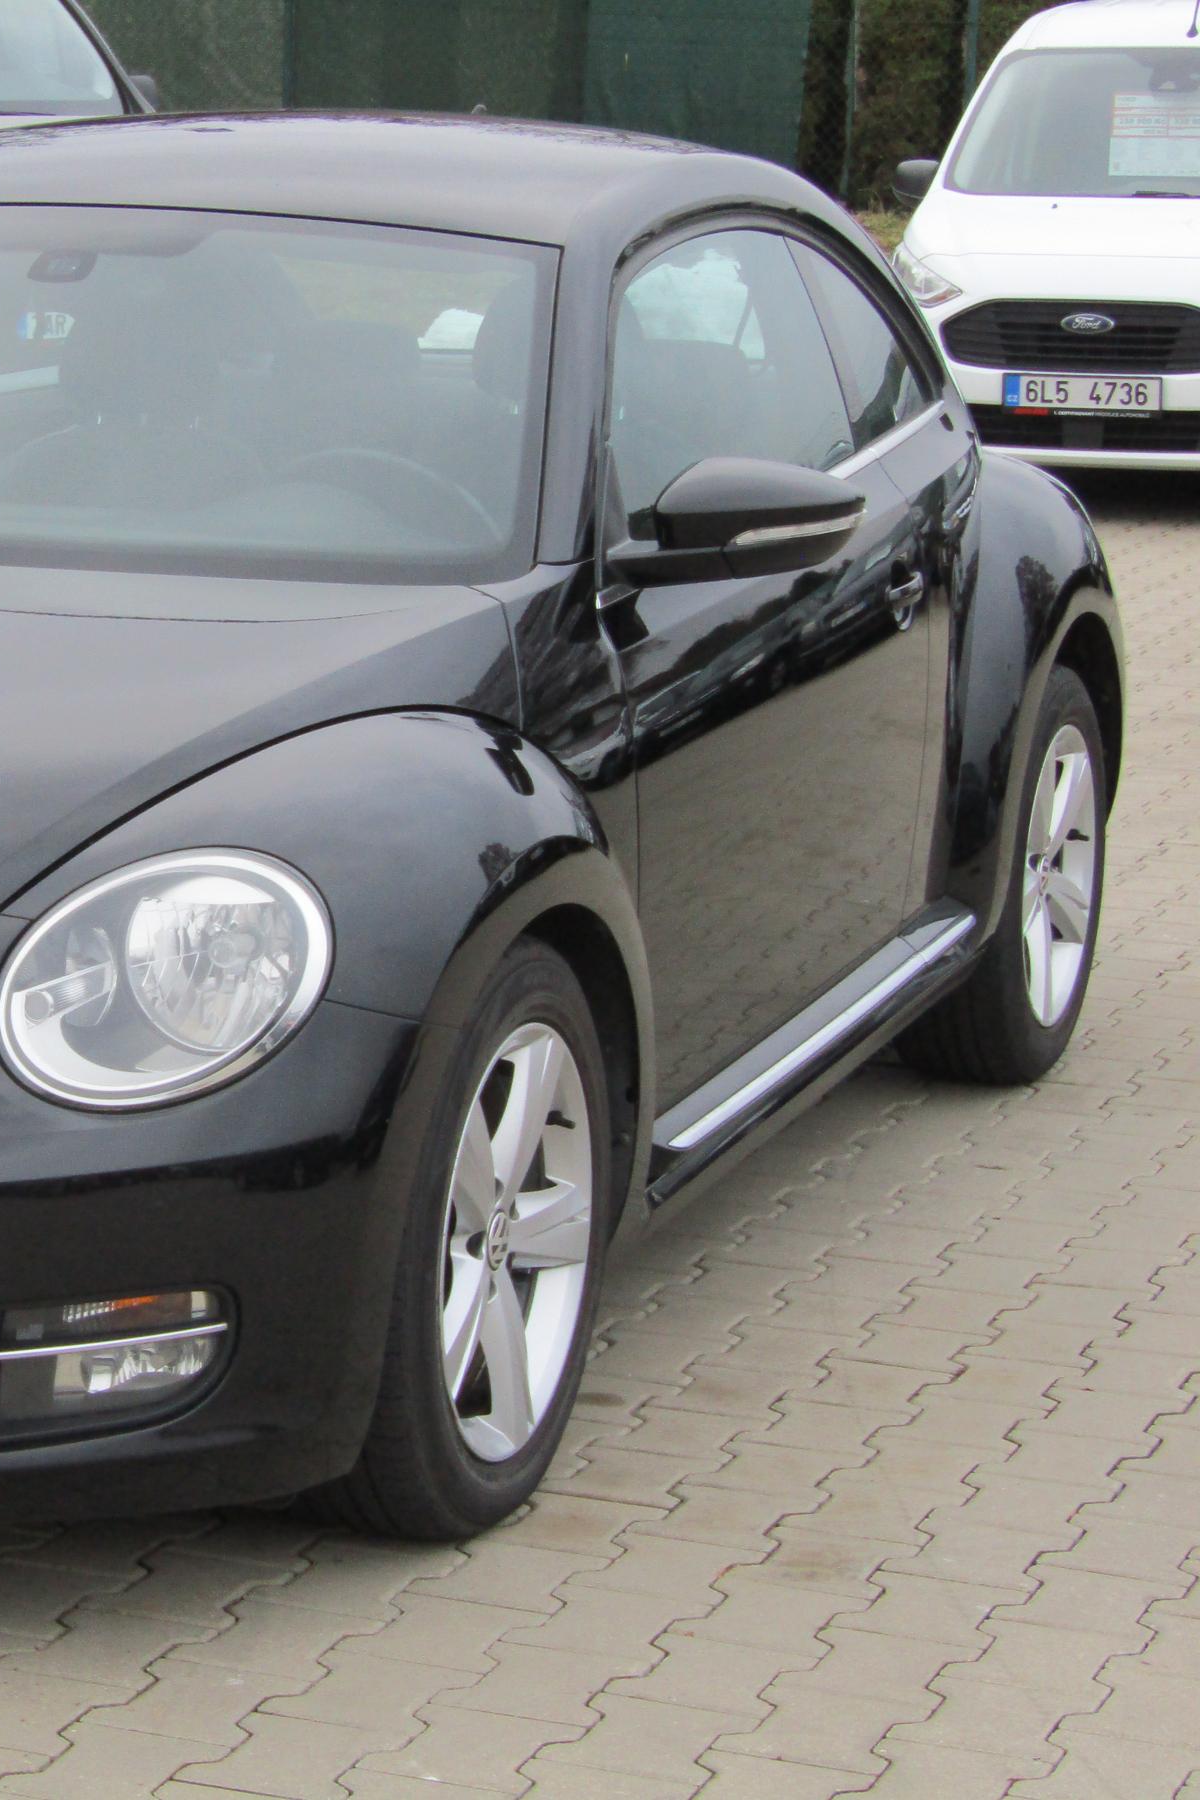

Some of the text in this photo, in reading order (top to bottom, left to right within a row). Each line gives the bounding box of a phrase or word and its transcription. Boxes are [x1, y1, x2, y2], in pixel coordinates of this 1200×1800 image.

[1072, 316, 1102, 329] Ford
[1025, 380, 1147, 406] 6L5 4736
